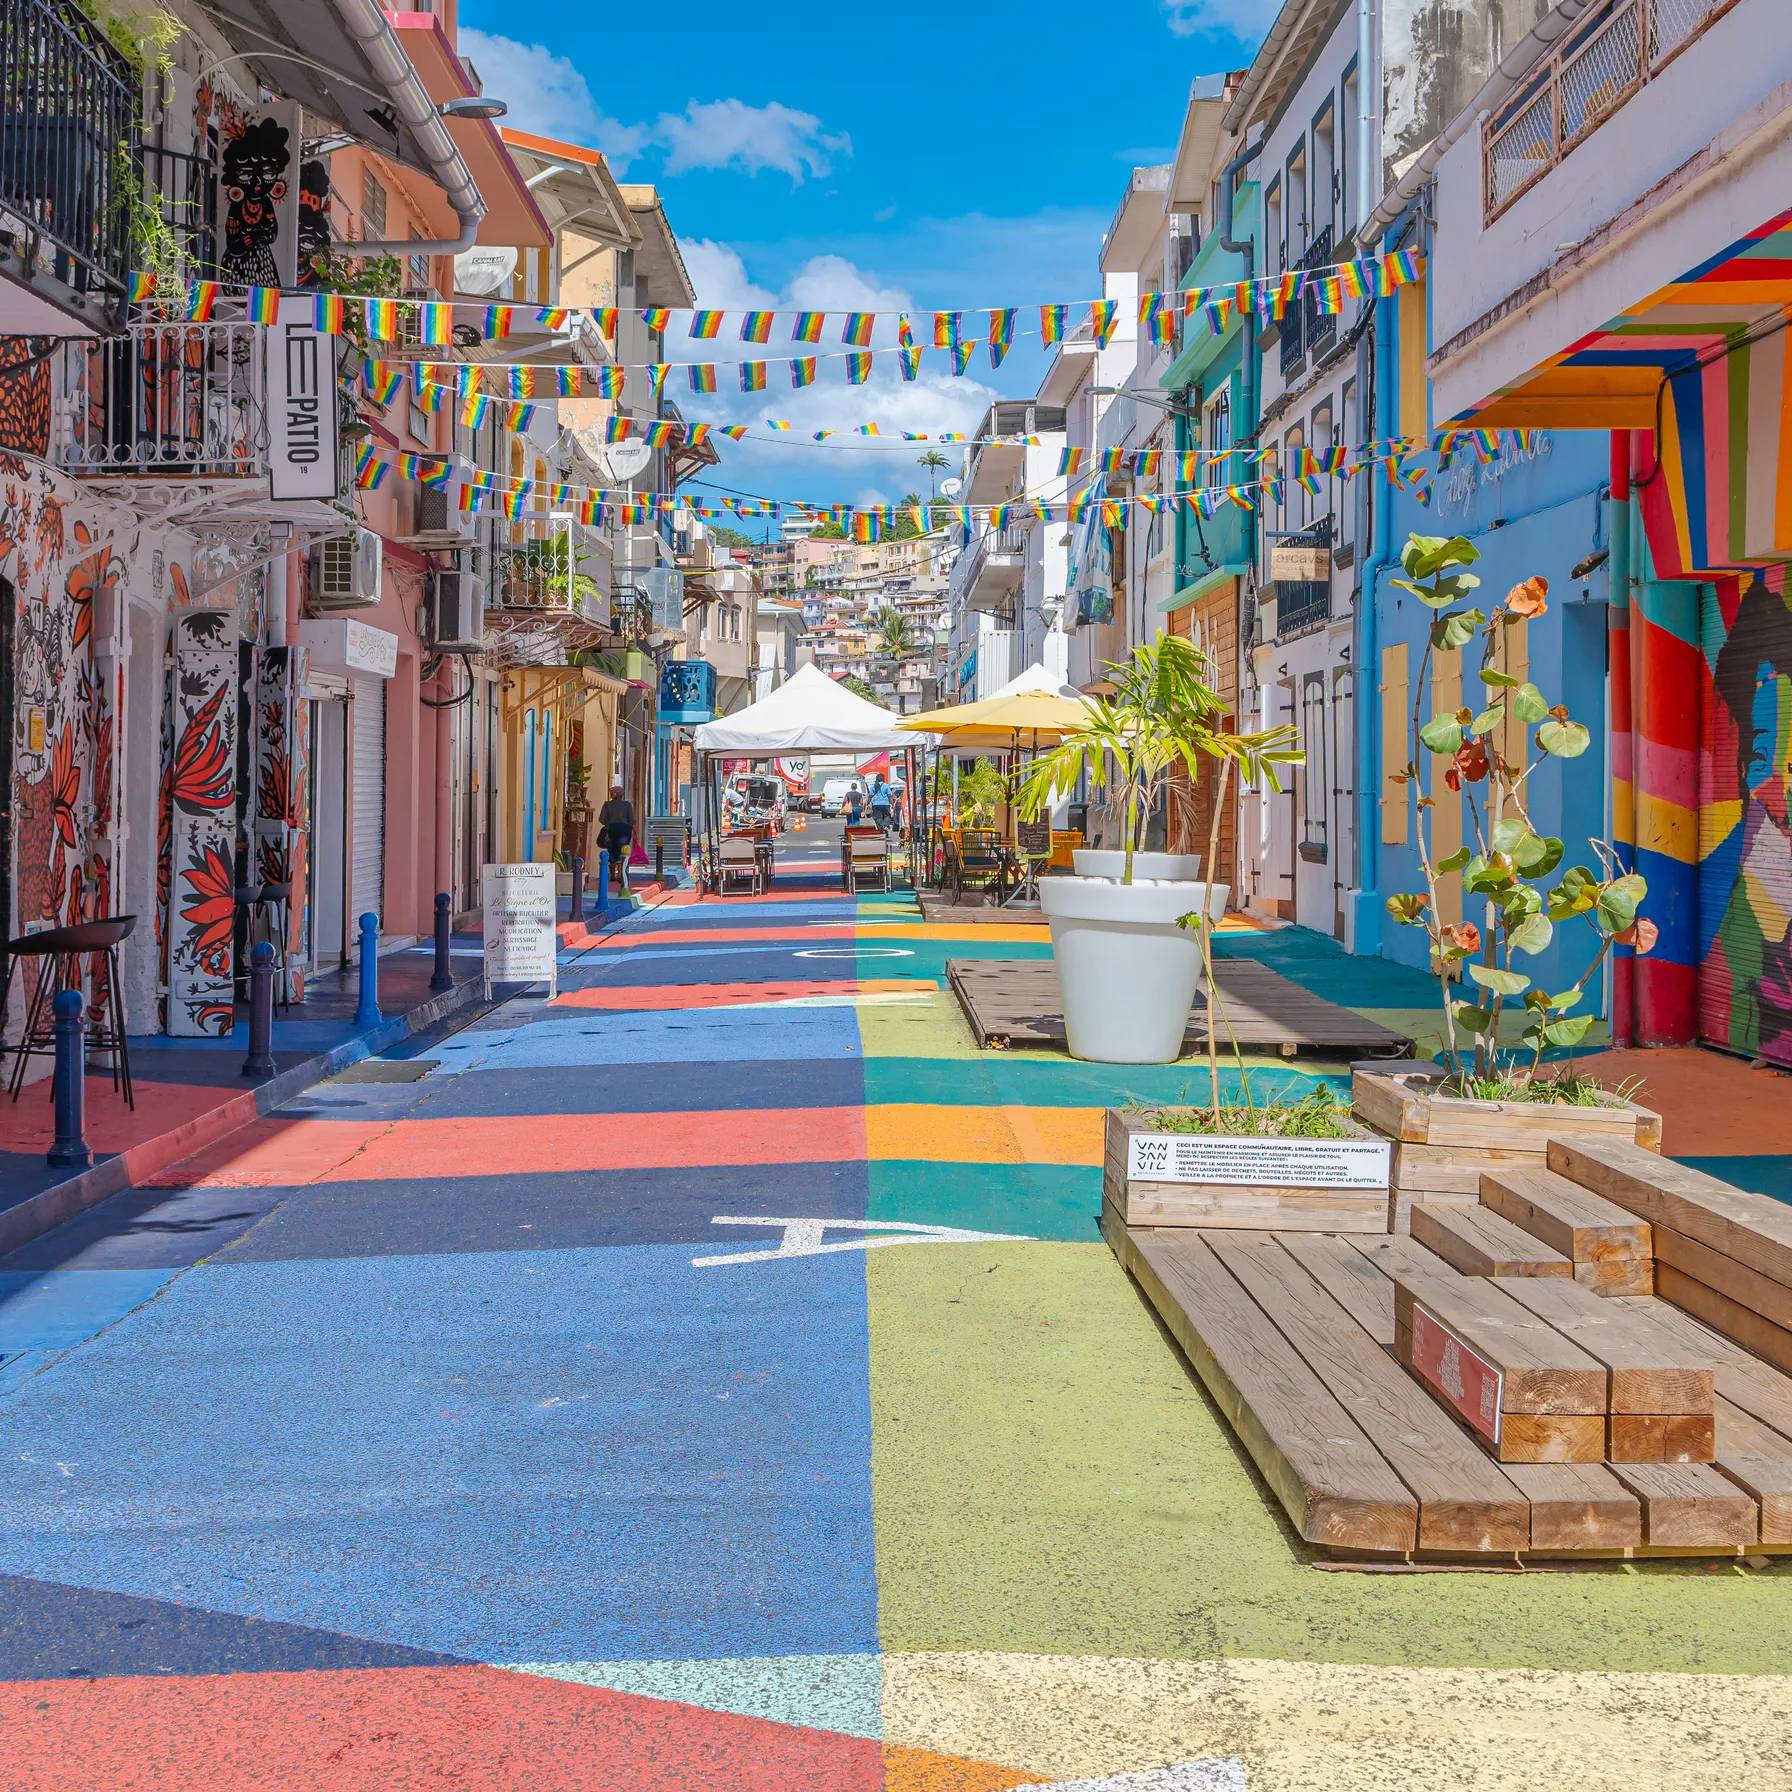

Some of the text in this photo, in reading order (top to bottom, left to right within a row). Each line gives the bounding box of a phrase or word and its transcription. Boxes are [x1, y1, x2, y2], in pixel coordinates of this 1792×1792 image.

[286, 323, 320, 464] LE PATIO
[300, 466, 308, 474] 19
[500, 867, 540, 876] R. RODNEY
[489, 896, 552, 909] Le Signe d'Or
[1138, 1142, 1168, 1151] VAN
[1137, 1162, 1166, 1170] VIL
